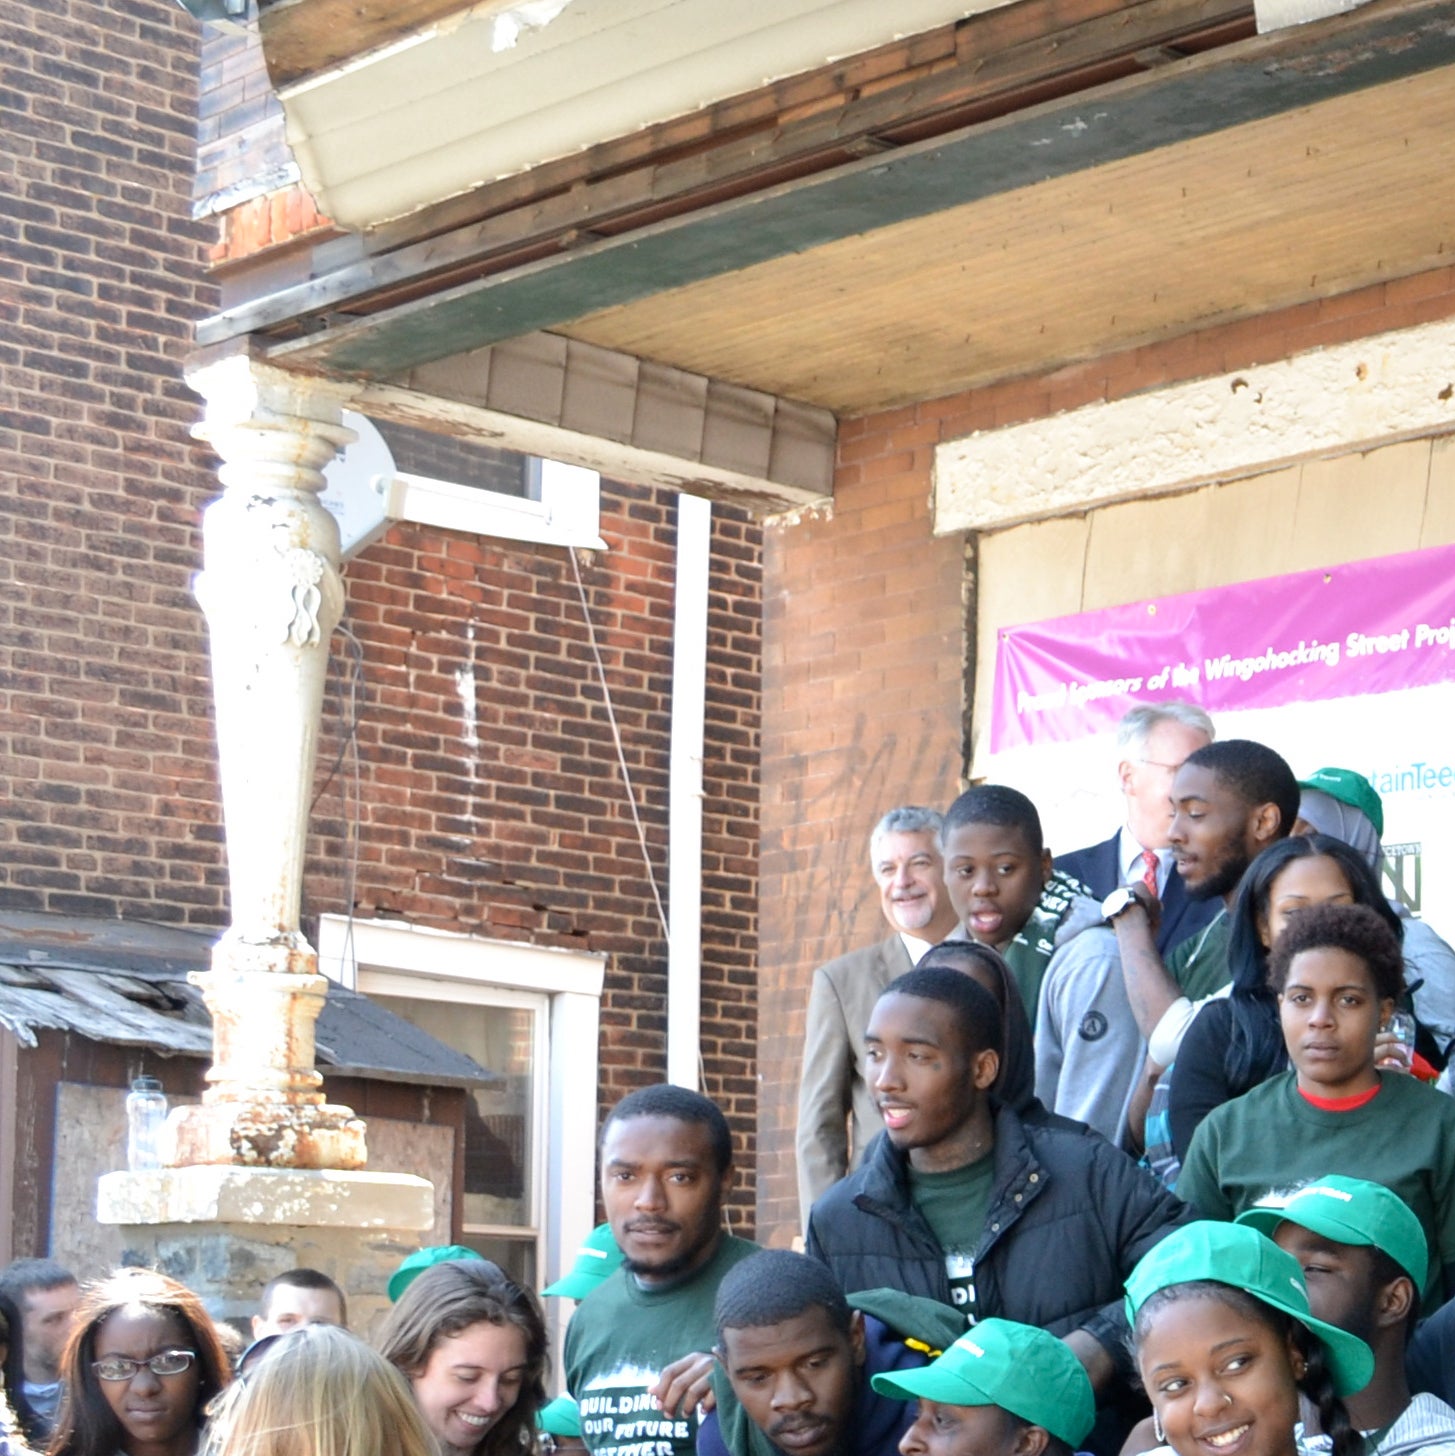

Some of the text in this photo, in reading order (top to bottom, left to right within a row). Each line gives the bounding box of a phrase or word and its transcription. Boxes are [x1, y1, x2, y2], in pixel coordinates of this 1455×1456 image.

[1147, 666, 1172, 690] of
[1172, 664, 1199, 687] the
[1205, 640, 1340, 682] Wingohocking
[1346, 631, 1409, 658] Street
[584, 1417, 690, 1440] OUR FUTURE
